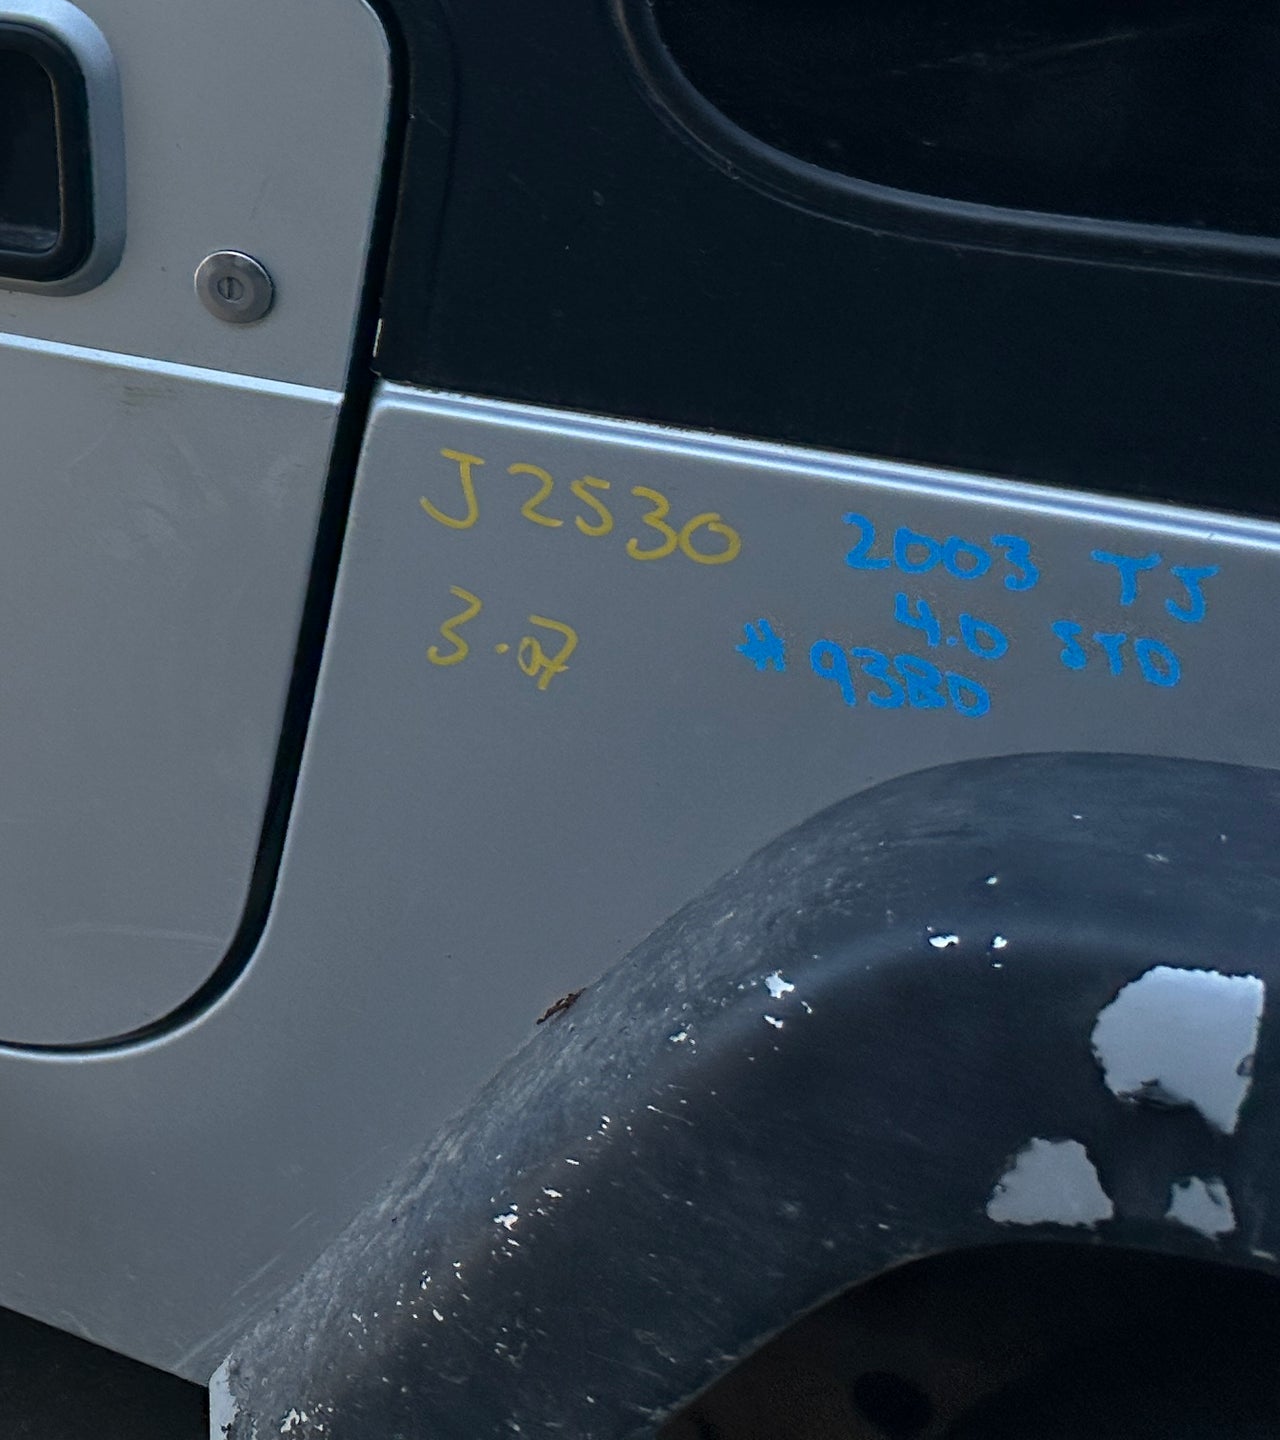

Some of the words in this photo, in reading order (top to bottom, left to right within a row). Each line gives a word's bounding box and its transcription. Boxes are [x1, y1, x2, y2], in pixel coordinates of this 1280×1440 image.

[419, 447, 742, 566] J2530
[842, 512, 1041, 592] 2003
[1091, 549, 1220, 624] TJ
[894, 592, 1010, 660] 4.0
